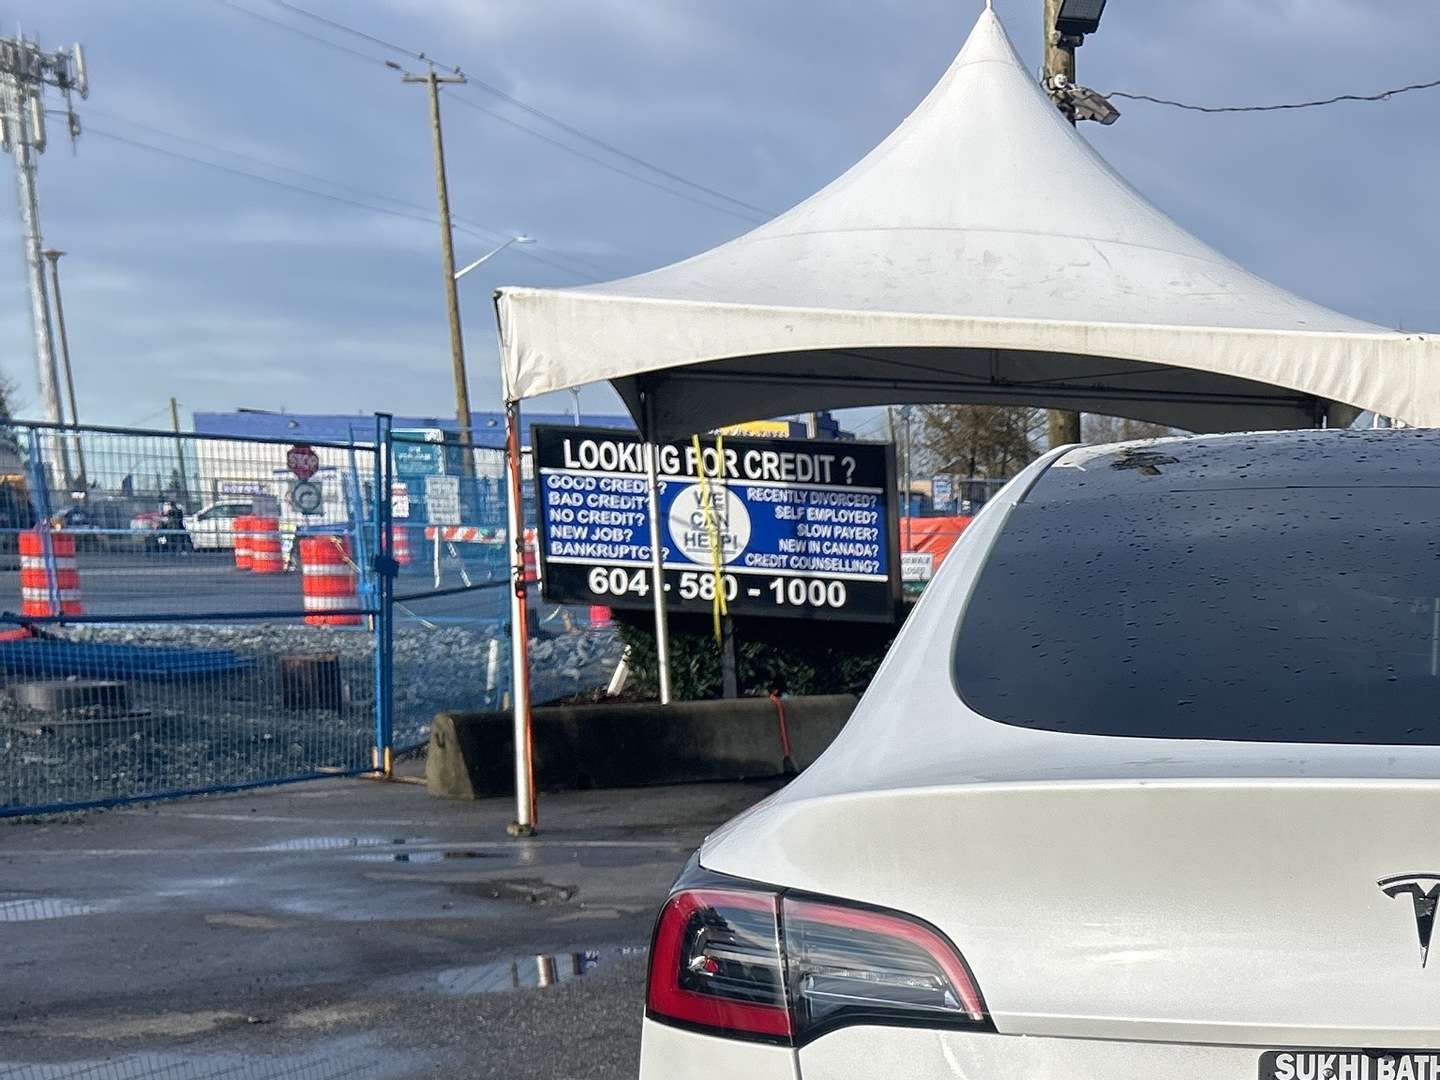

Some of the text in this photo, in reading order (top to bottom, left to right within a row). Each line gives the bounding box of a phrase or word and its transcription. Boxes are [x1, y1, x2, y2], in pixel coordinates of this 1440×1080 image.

[685, 445, 739, 478] FOR
[743, 450, 835, 483] CREDIT
[547, 475, 668, 495] GOOD CREDI?
[548, 491, 583, 507] BAD
[747, 487, 877, 508] RECENTLY DIVORCED?
[549, 508, 645, 526] NO CREDIT?
[775, 505, 878, 524] SELF EMPLOYED?
[550, 525, 633, 542] NEW JOB?
[684, 532, 738, 550] HEP!
[797, 523, 879, 541] SLOW PAYER?
[551, 541, 670, 560] BANKRUPTC?
[779, 538, 879, 557] NEW IN CANADA?
[745, 553, 880, 573] CREDIT COUNSELLING?
[588, 567, 649, 597] 604
[679, 572, 738, 601] 580
[769, 577, 847, 607] 1000
